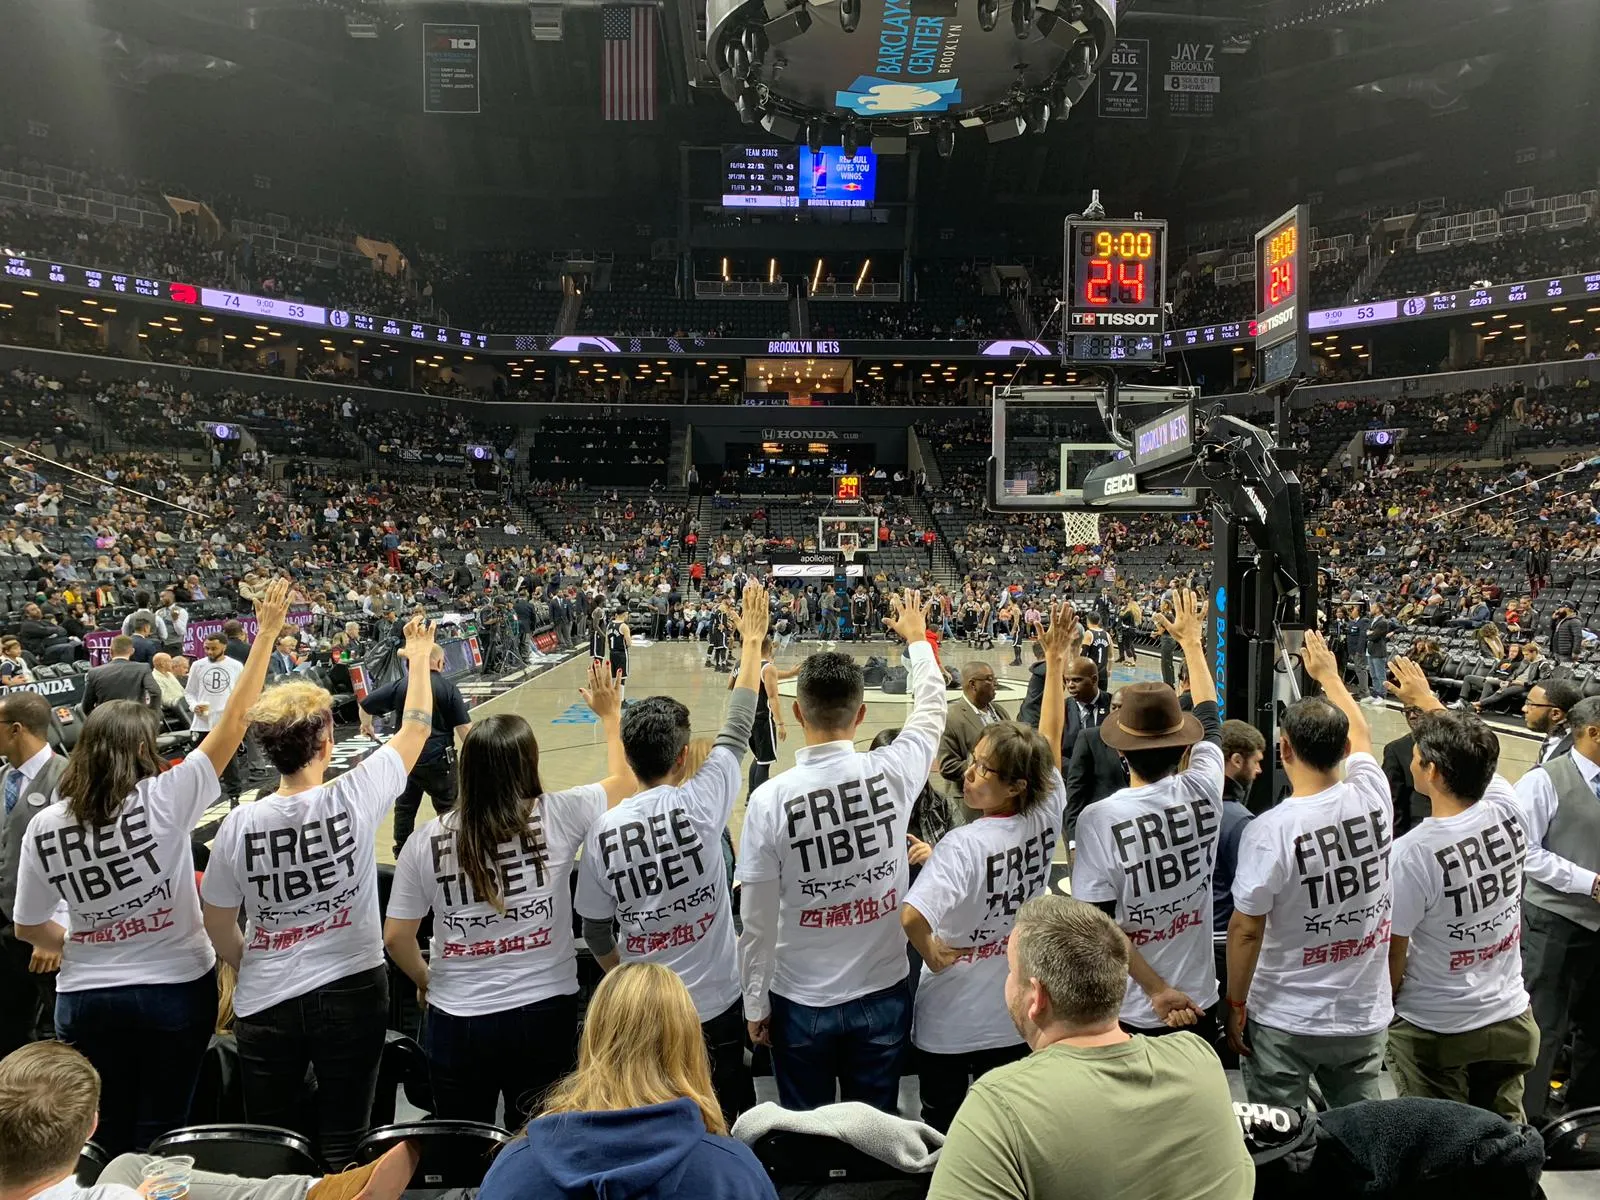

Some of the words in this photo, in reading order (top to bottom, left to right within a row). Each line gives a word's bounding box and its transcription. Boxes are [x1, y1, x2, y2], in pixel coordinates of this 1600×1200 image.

[907, 16, 945, 74] CENTER
[938, 25, 962, 73] BROOKLYN
[1171, 43, 1200, 60] JAY
[1205, 44, 1215, 61] Z
[1112, 53, 1139, 65] B.I.G.
[1170, 62, 1214, 71] BROOKLYN
[1110, 72, 1138, 92] 72
[1171, 77, 1180, 89] 8
[745, 149, 760, 157] TEAM
[761, 149, 778, 157] STATS
[852, 155, 867, 164] BULL
[836, 164, 855, 172] GIVES
[856, 164, 870, 172] YOU
[1097, 231, 1152, 257] 9:00
[8, 258, 24, 266] 3PT
[51, 265, 61, 273] FT
[4, 265, 32, 277] 14/24
[85, 271, 102, 279] REB
[88, 279, 100, 288] 29
[112, 275, 127, 284] AST
[136, 279, 152, 288] FLS:
[1087, 260, 1144, 303] 24
[1270, 262, 1291, 303] 24
[1586, 282, 1600, 291] 22
[114, 283, 125, 292] 16
[136, 286, 152, 295] TOL:
[1547, 287, 1562, 297] 3/3
[223, 294, 241, 308] 74
[1469, 297, 1492, 307] 22/51
[1508, 292, 1527, 301] 6/21
[256, 299, 274, 309] 9:00
[1433, 303, 1450, 311] TOL:
[288, 305, 305, 318] 53
[1268, 306, 1295, 330] TISSOT
[1325, 311, 1343, 320] 9:00
[1357, 307, 1375, 319] 53
[1096, 313, 1159, 326] TISSOT
[768, 341, 813, 353] BROOKLYN
[816, 341, 840, 354] NETS
[777, 430, 839, 440] HONDA
[1139, 423, 1168, 455] BROOKLYN
[1170, 414, 1187, 442] NETS
[839, 485, 856, 498] 24
[1104, 473, 1136, 496] GEICO
[800, 554, 835, 564] apollojets
[196, 625, 223, 641] QATAR
[1097, 647, 1102, 663] 1
[783, 773, 895, 838] FREE
[1111, 799, 1218, 863] FREE
[35, 806, 153, 872] FREE
[245, 812, 355, 872] FREE
[598, 808, 699, 870] FREE
[790, 814, 897, 873] TIBET
[1293, 807, 1392, 875] FREE
[1434, 815, 1527, 888] FREE
[987, 827, 1056, 893] FREE
[1124, 836, 1216, 898] TIBET
[48, 842, 161, 903] TIBET
[248, 847, 357, 903] TIBET
[607, 843, 704, 904] TIBET
[1301, 847, 1392, 909] TIBET
[436, 854, 550, 906] TIBET
[799, 888, 898, 929] 西藏独立
[626, 912, 716, 955] 西藏独立
